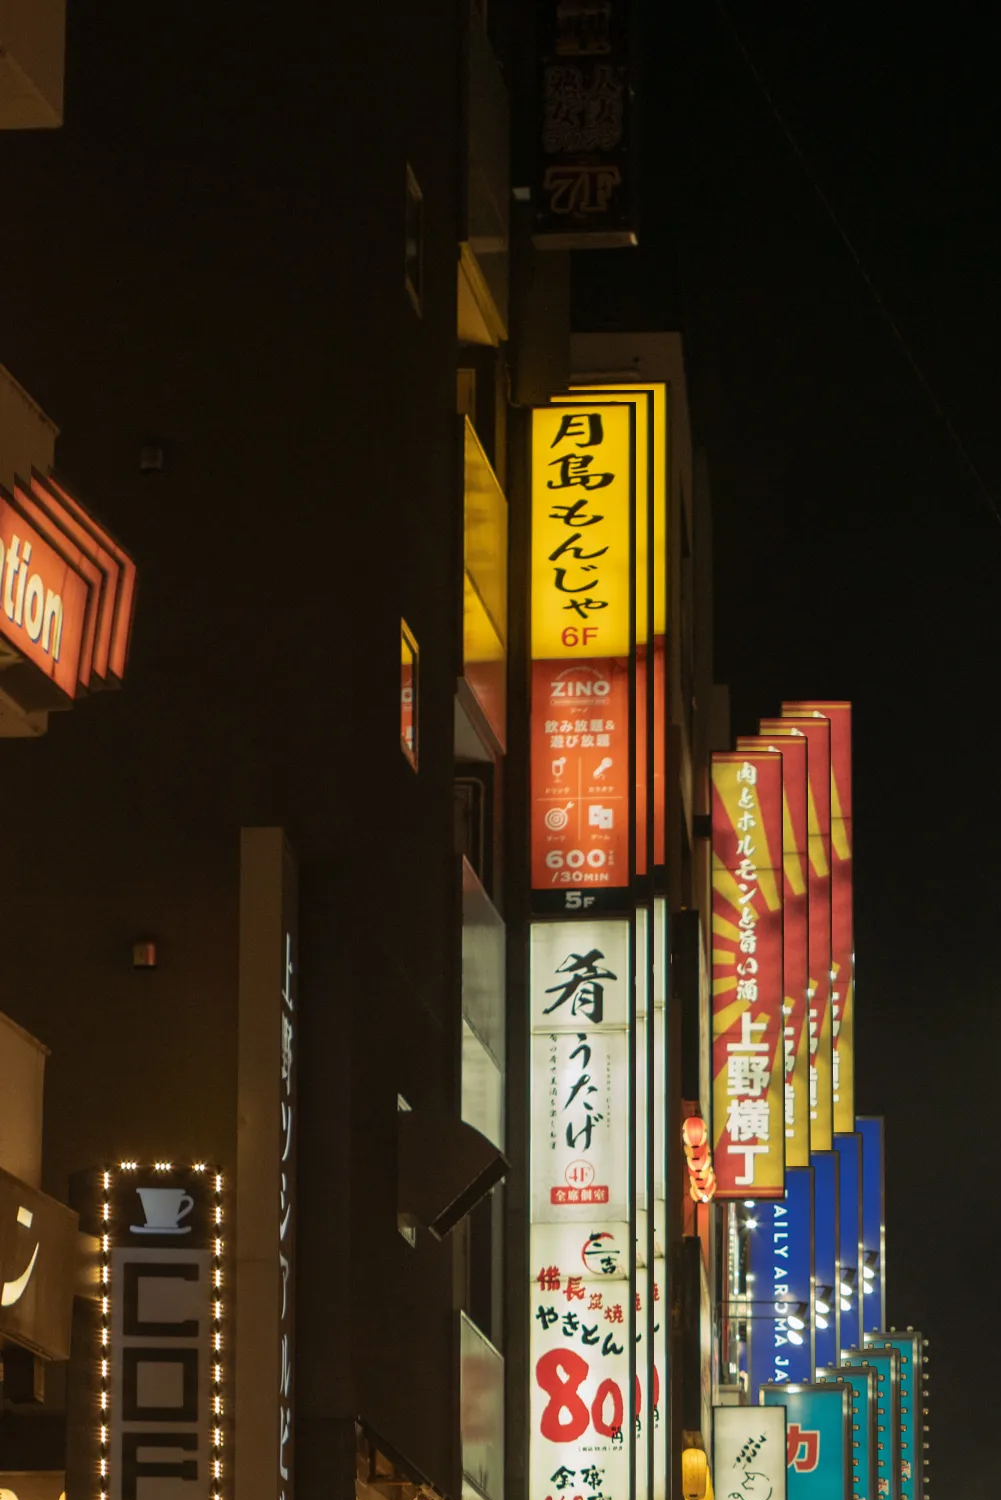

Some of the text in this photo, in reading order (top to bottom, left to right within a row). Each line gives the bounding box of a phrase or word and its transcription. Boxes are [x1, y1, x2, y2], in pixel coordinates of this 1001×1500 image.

[547, 413, 615, 620] 月島もんじゃ
[0, 534, 63, 664] tion
[561, 626, 599, 648] 6F
[550, 680, 611, 698] ZINO
[549, 733, 611, 748] 遊び放題
[545, 849, 606, 869] 600
[551, 870, 610, 883] /30MIN
[564, 890, 596, 909] 5F
[562, 1032, 604, 1153] うたげ
[725, 1011, 771, 1186] 上野横丁
[568, 1166, 591, 1183] 4F
[555, 1188, 606, 1202] 全席個室
[773, 1190, 789, 1258] AILY
[535, 1304, 625, 1357] やきとん
[535, 1347, 624, 1443] 80
[550, 1464, 606, 1490] 全席
